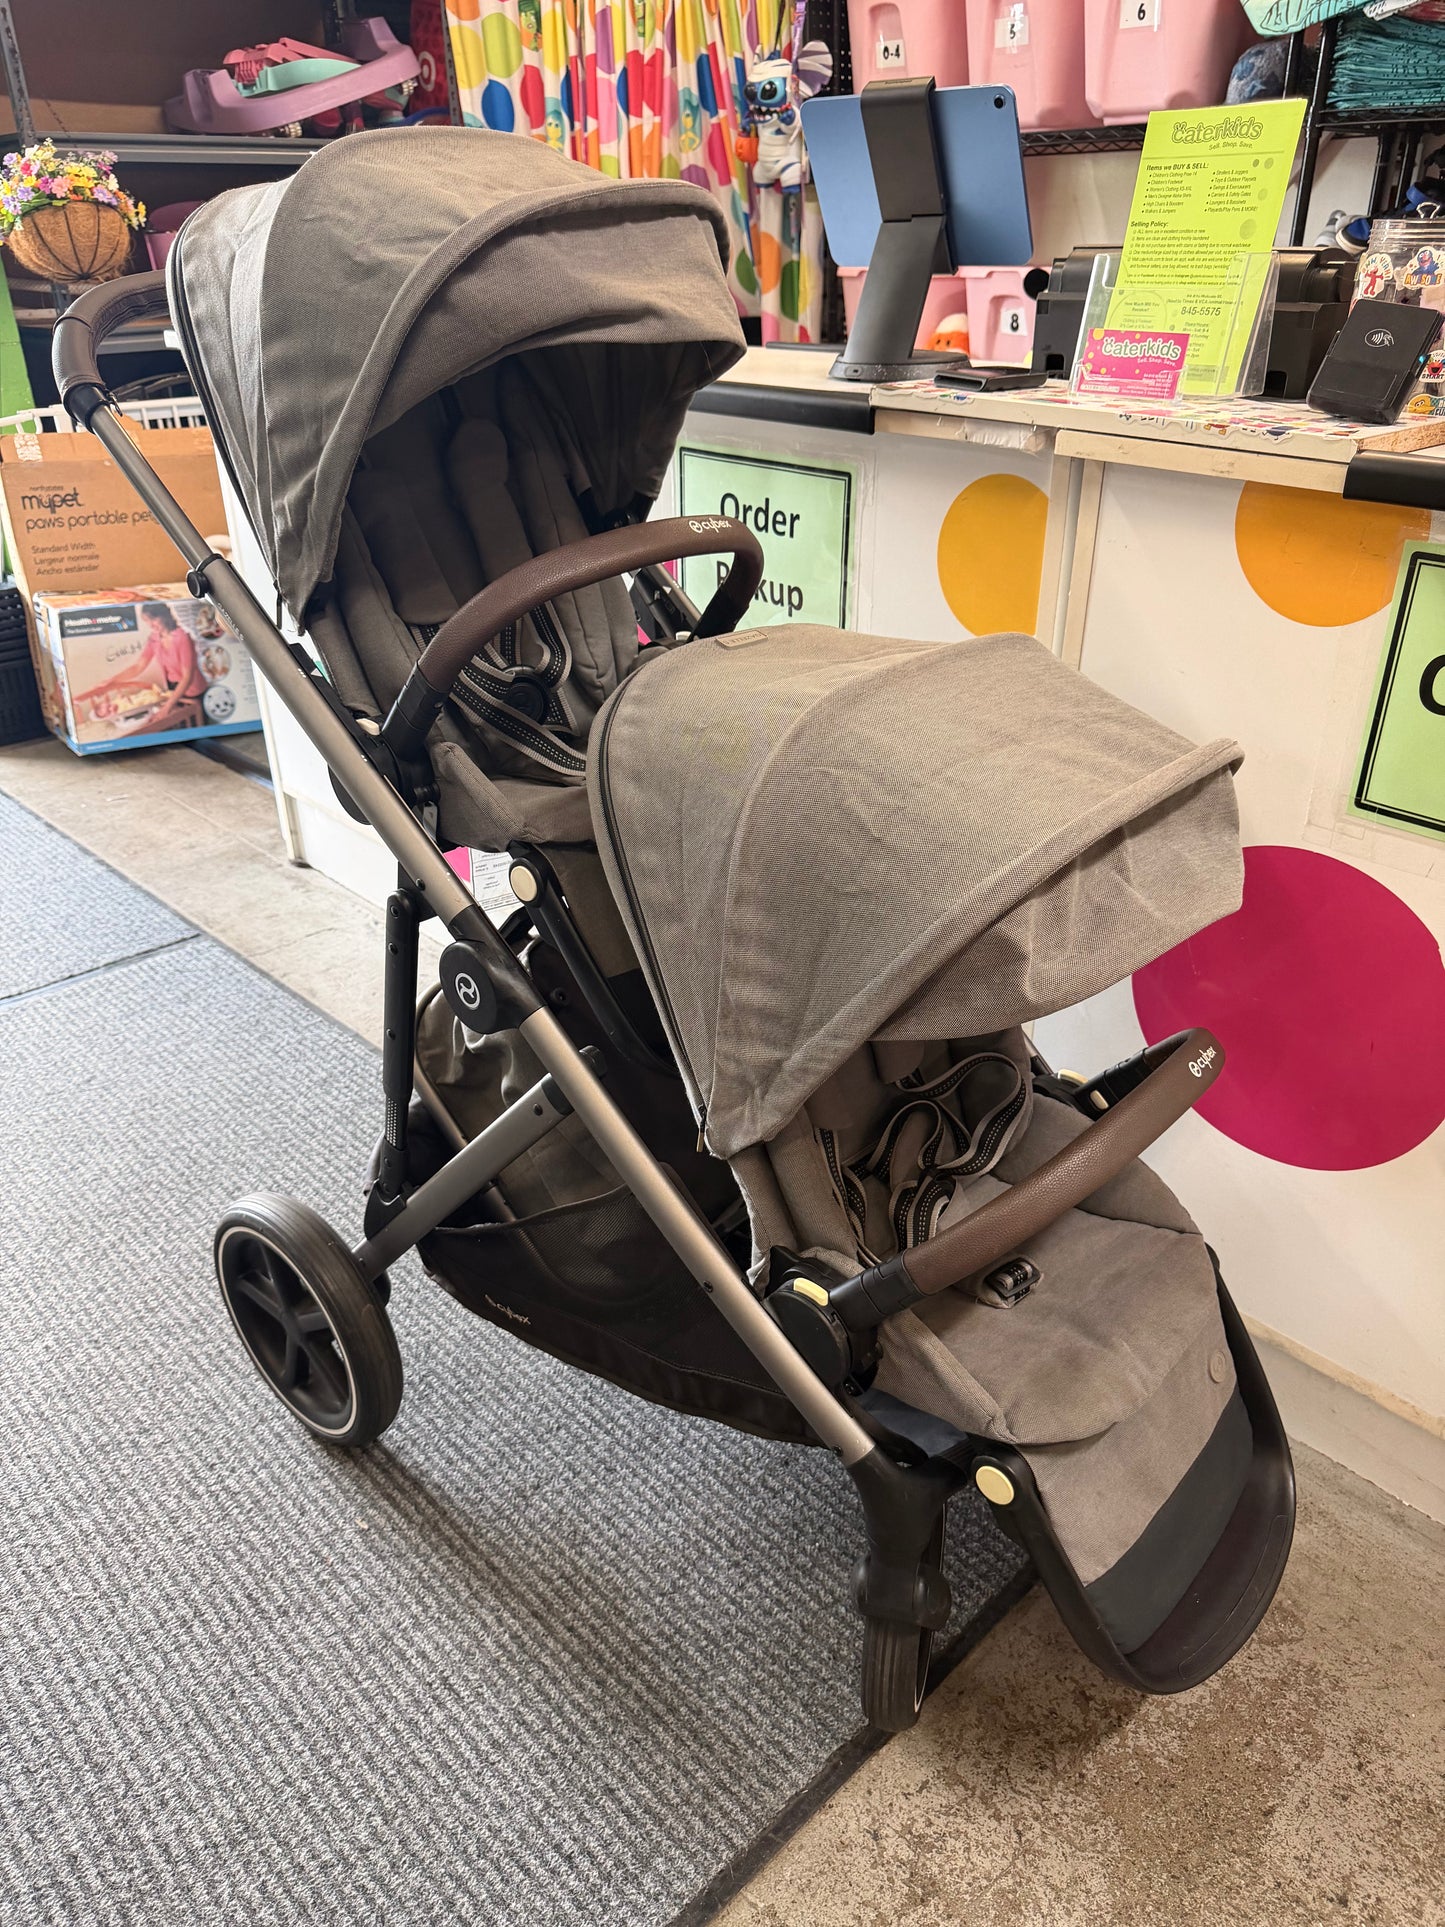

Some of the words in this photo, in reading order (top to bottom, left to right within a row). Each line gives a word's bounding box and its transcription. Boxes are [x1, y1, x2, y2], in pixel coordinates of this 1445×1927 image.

[1137, 3, 1146, 21] 6
[1009, 24, 1017, 39] 5
[1181, 306, 1221, 316] 845-5575
[1011, 313, 1019, 333] 8
[21, 487, 86, 514] mypet
[25, 517, 65, 533] paws
[67, 510, 129, 531] portable
[720, 492, 800, 539] Order
[701, 517, 732, 533] cybex
[31, 544, 69, 554] Standard
[71, 542, 96, 551] Width
[33, 556, 65, 567] Largeur
[67, 554, 99, 562] normale
[36, 566, 63, 575] Ancho
[717, 561, 803, 617] Pkup
[1196, 1045, 1217, 1069] cybex
